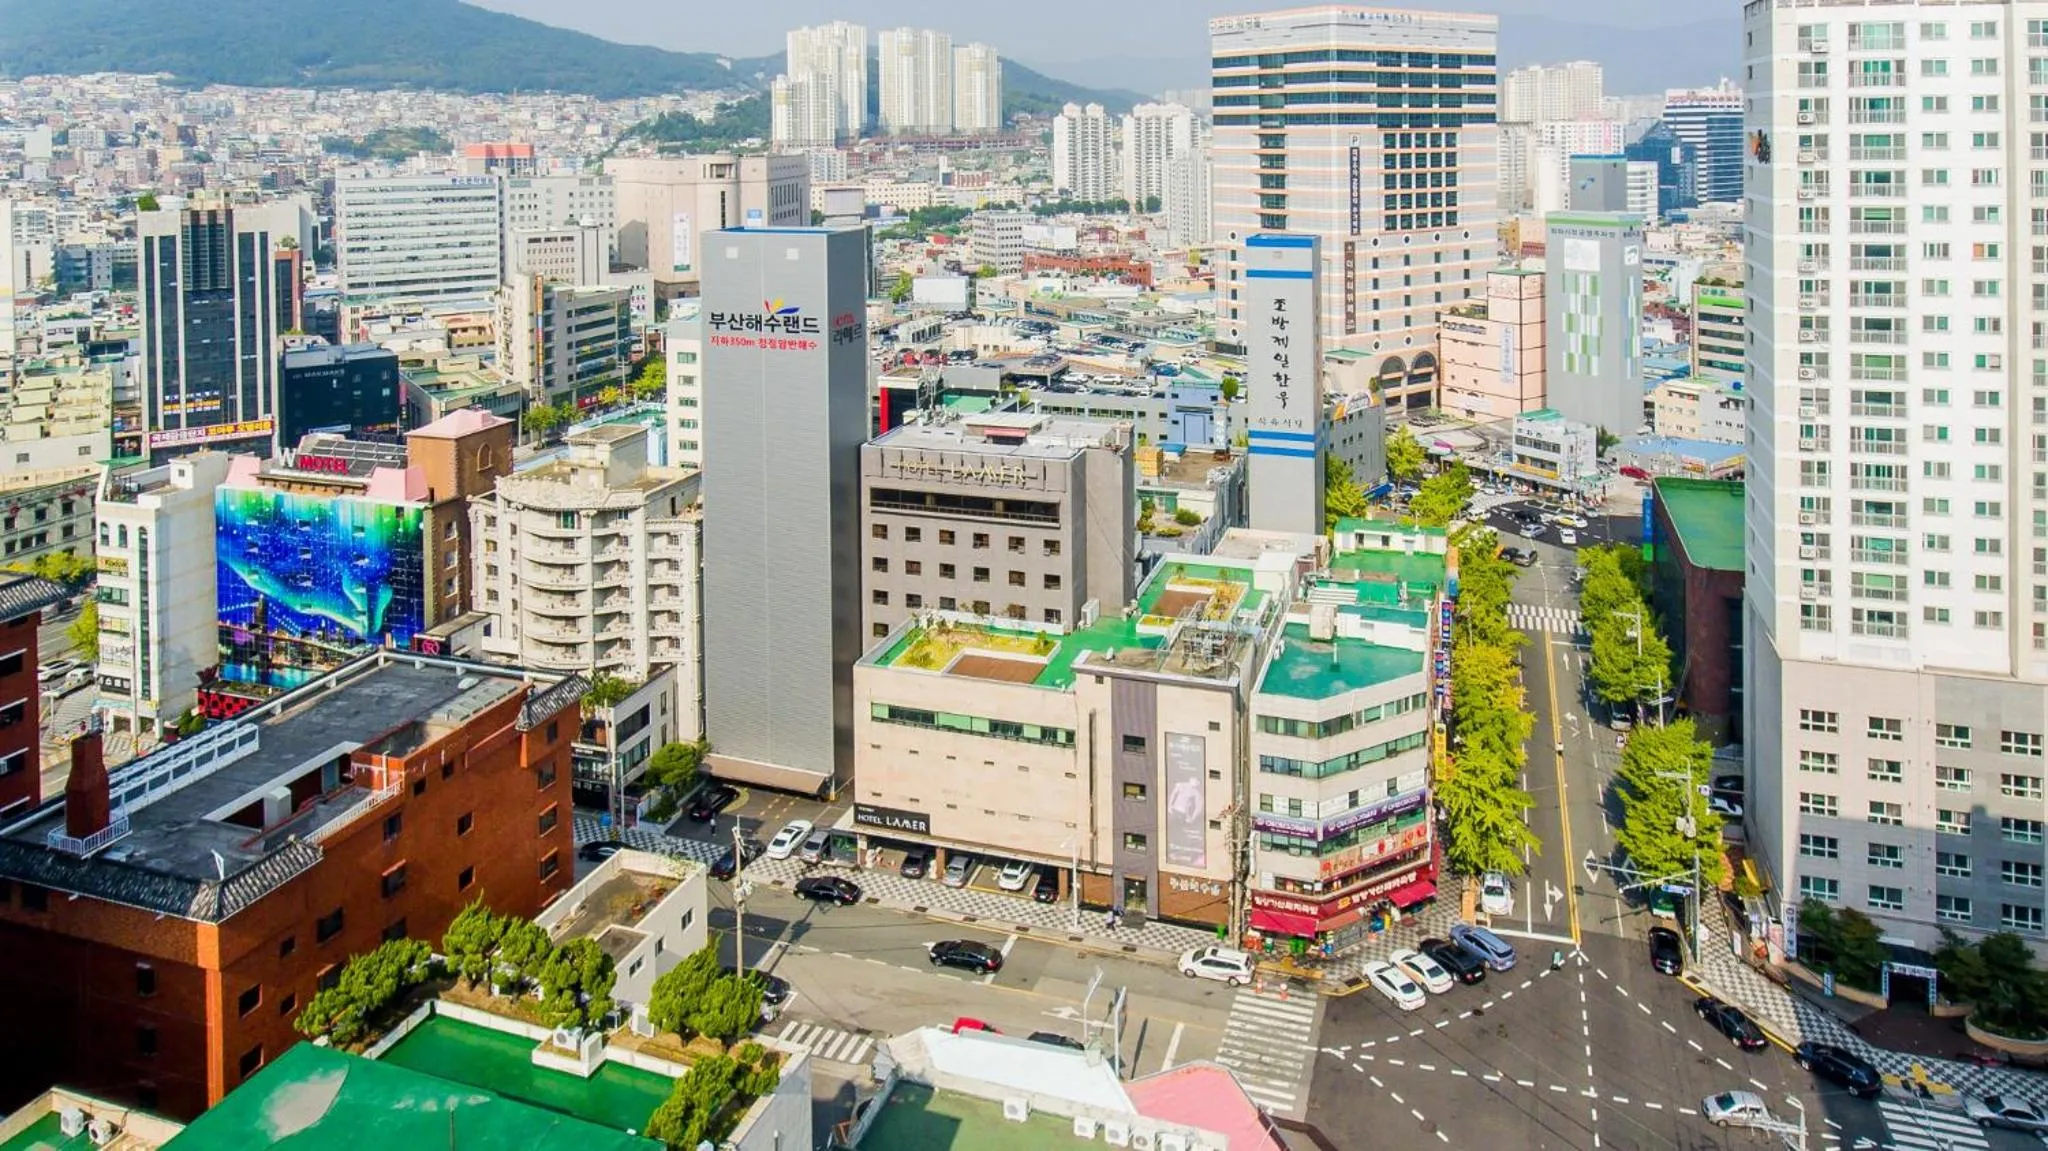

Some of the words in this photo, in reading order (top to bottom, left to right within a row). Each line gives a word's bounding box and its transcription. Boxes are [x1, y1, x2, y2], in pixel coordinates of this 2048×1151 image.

[708, 311, 820, 334] 부산해수랜드
[710, 335, 755, 347] 지하350m
[1271, 298, 1291, 410] 조방제일한우
[280, 446, 297, 467] W
[298, 454, 349, 475] MOTEL
[951, 461, 1026, 484] LAMER
[858, 813, 884, 825] HOTEL
[886, 815, 927, 832] LAMER
